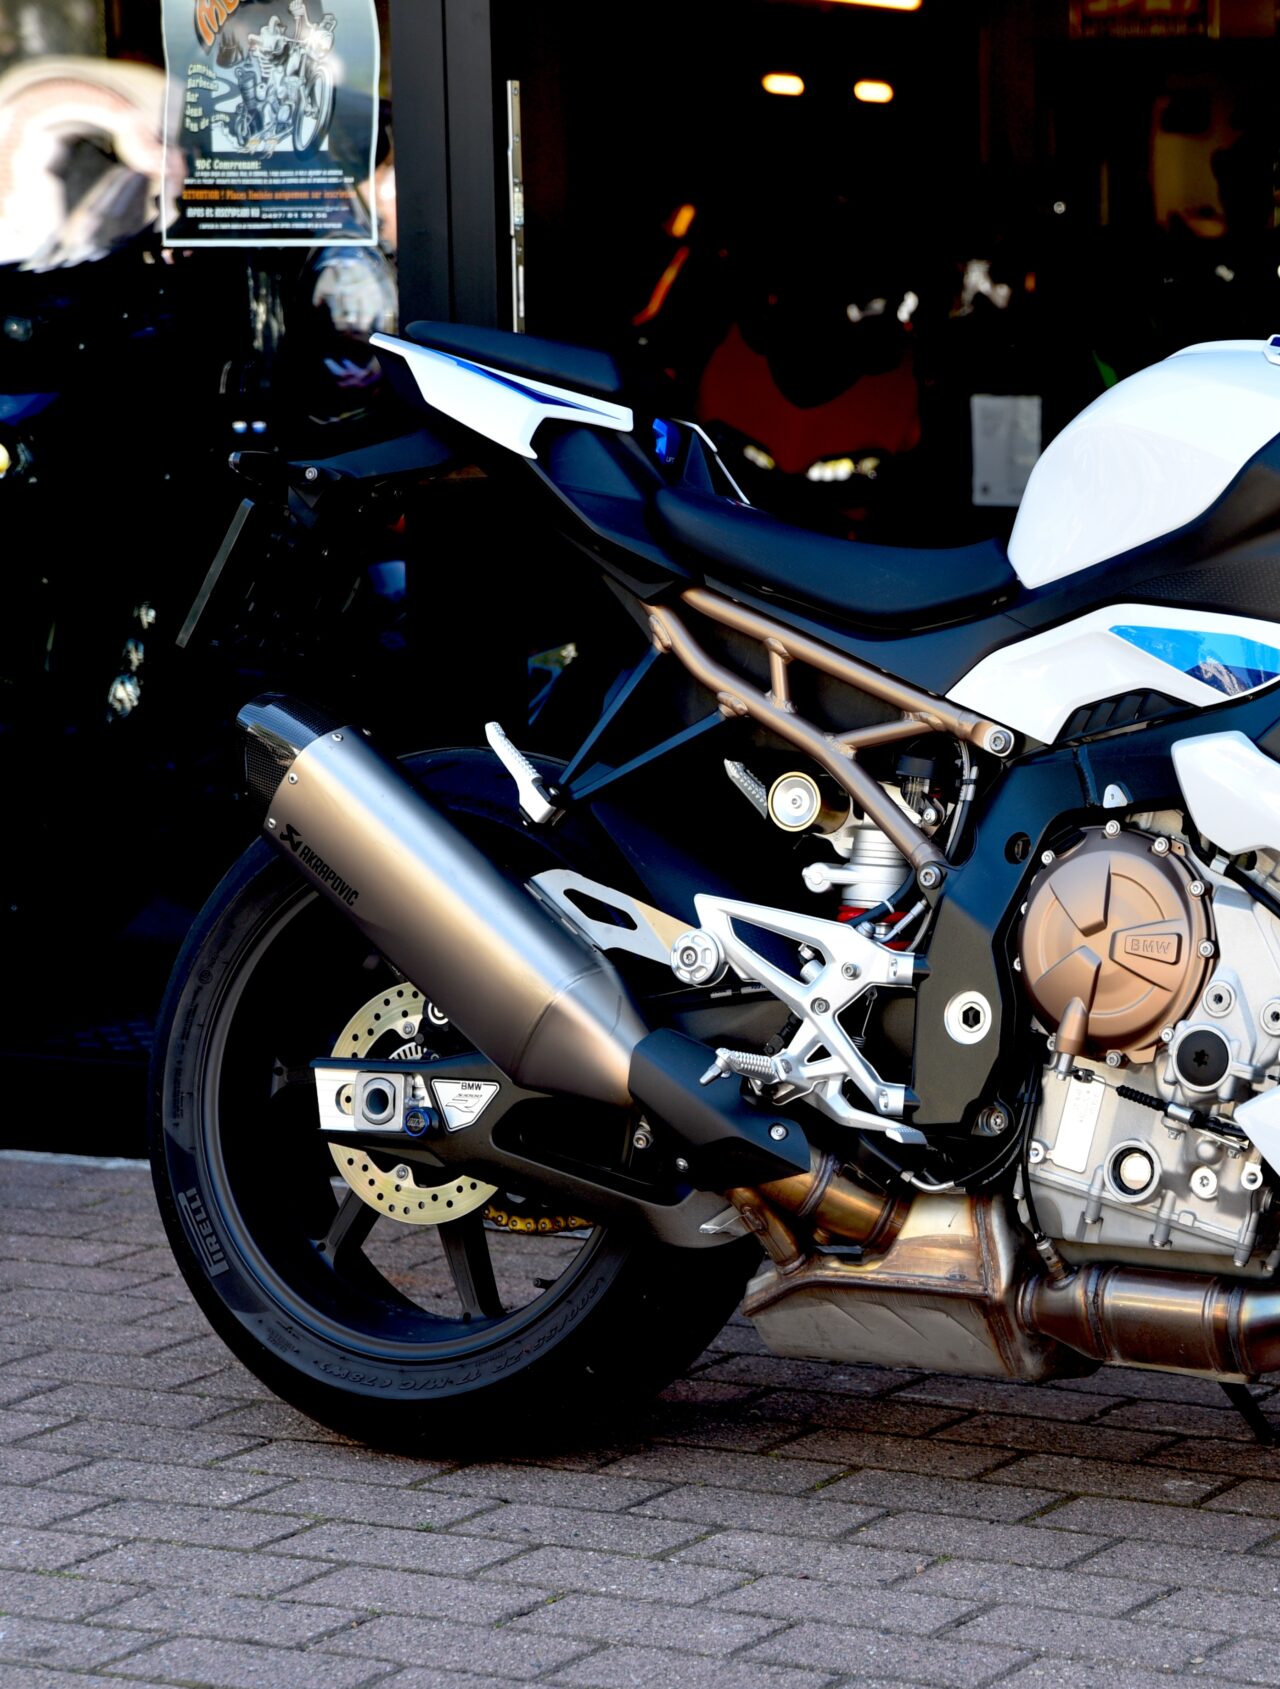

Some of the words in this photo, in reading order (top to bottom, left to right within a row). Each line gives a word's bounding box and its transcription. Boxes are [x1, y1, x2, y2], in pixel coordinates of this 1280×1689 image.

[1130, 938, 1172, 954] BMW
[461, 1082, 482, 1091] BMW
[177, 1187, 230, 1278] PIRELLI
